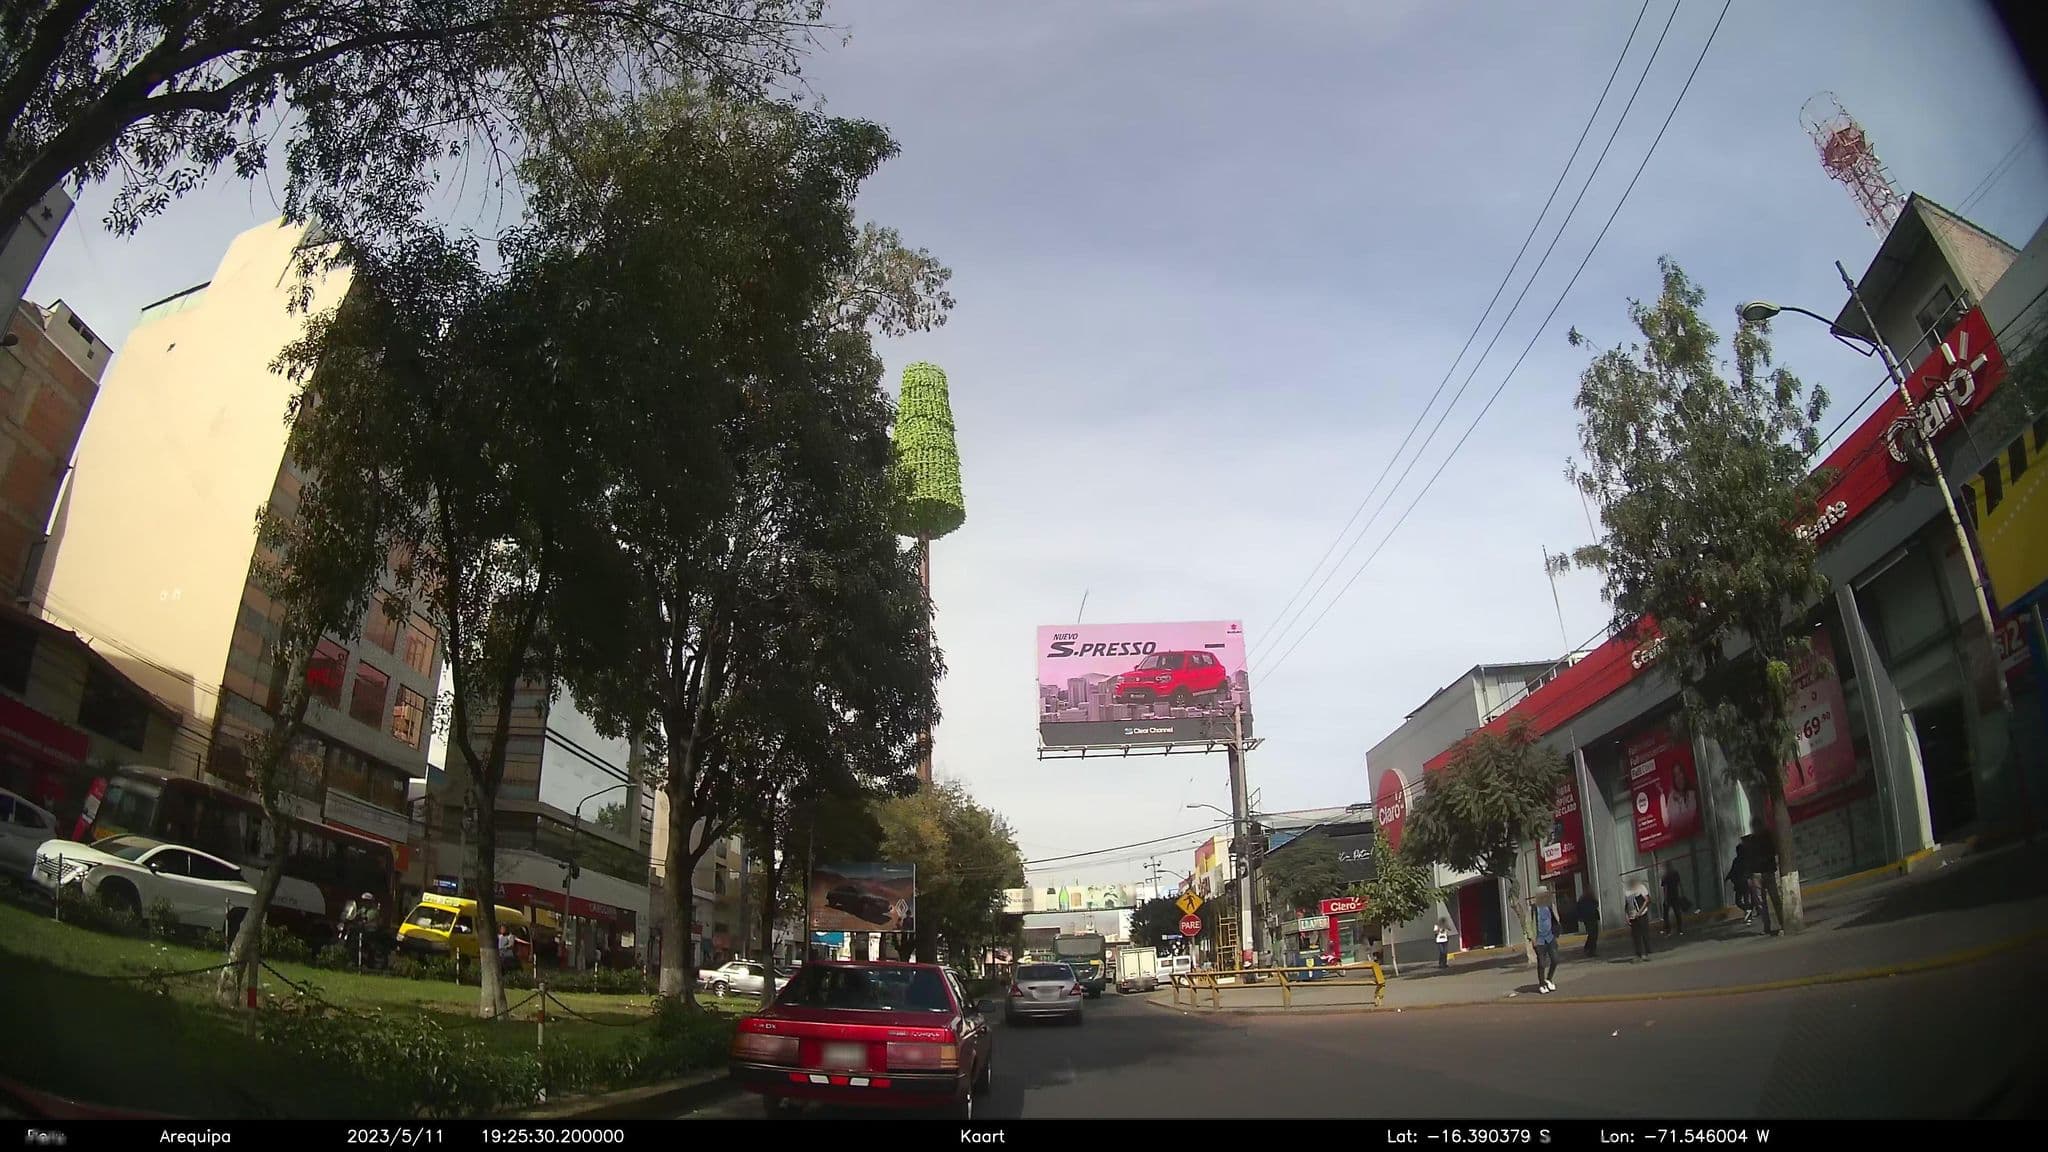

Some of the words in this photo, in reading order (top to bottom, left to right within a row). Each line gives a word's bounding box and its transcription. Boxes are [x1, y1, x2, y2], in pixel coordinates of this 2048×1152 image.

[1053, 633, 1079, 641] NUEVO
[1379, 804, 1401, 826] Claro
[1330, 901, 1356, 912] Claro
[1181, 921, 1201, 930] PARE
